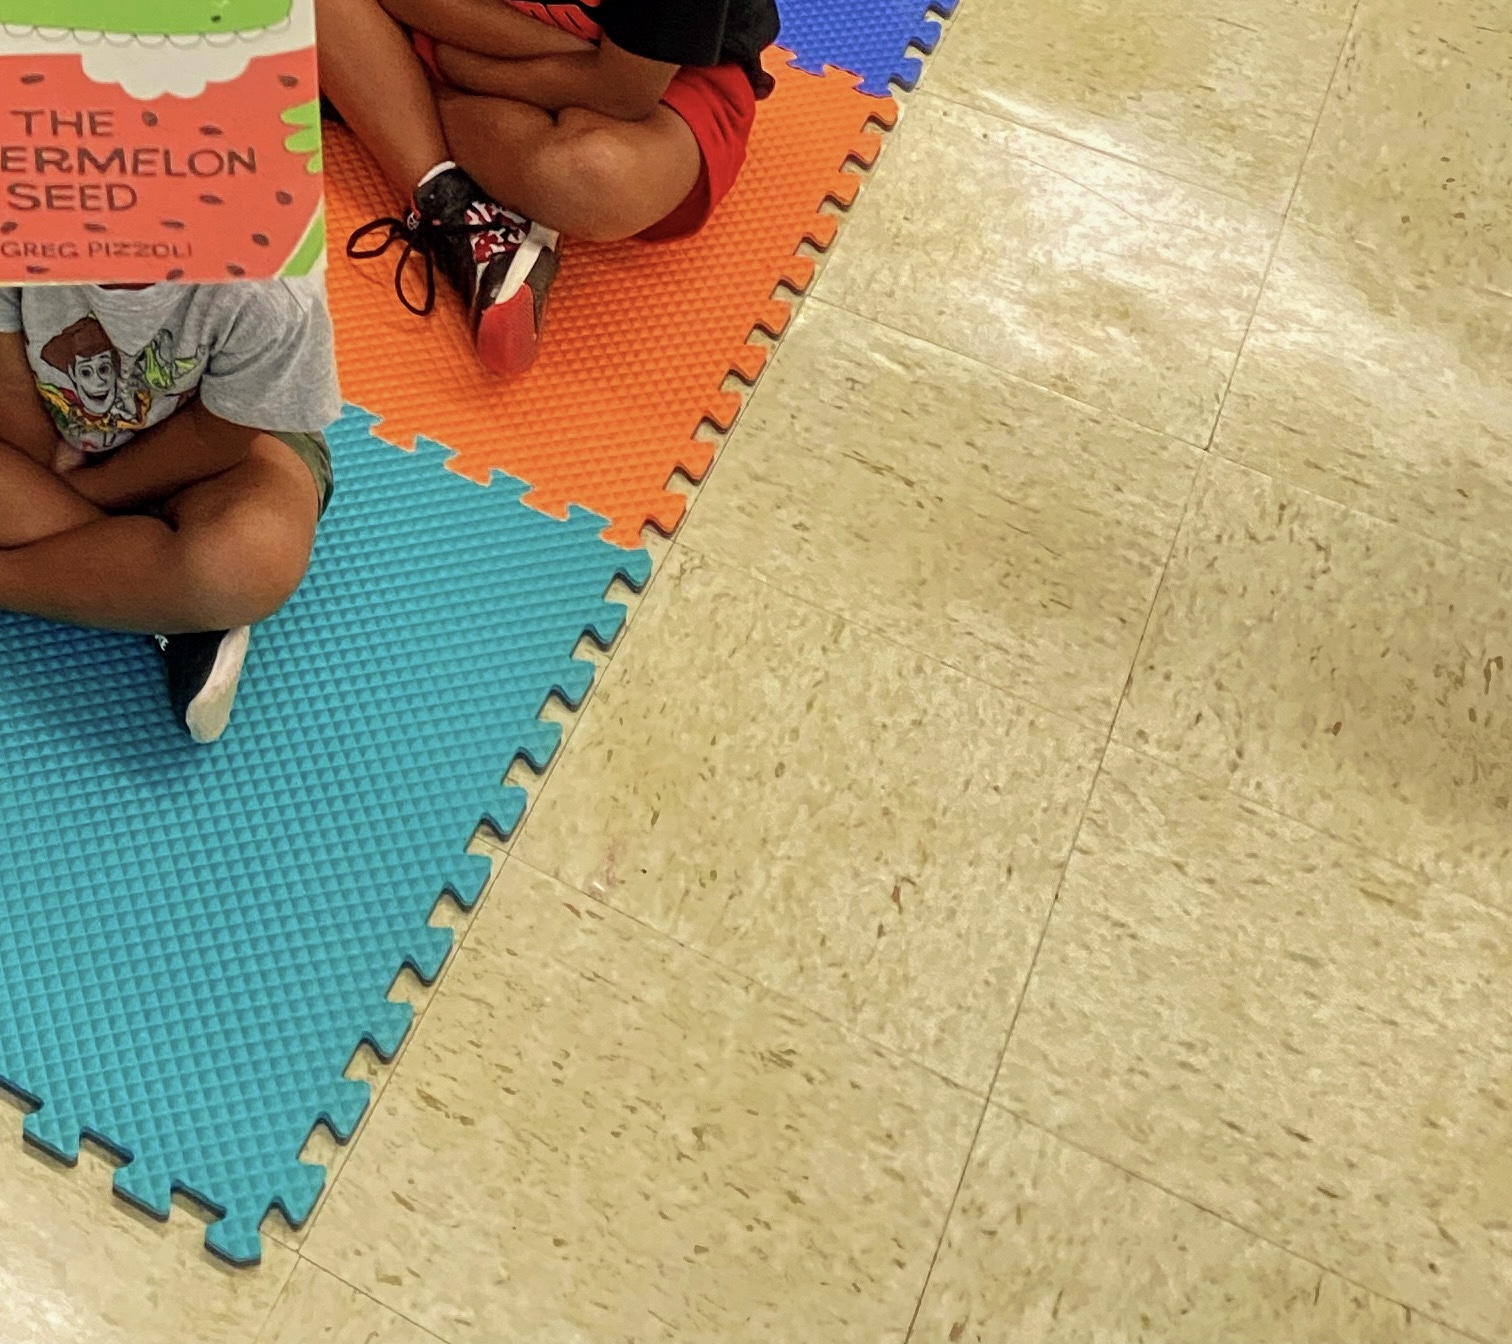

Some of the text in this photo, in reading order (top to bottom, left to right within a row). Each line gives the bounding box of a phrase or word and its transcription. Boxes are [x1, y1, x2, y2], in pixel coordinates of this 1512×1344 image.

[11, 109, 115, 139] THE
[6, 182, 138, 213] SEED
[0, 240, 194, 260] GREG PIZZOLI
